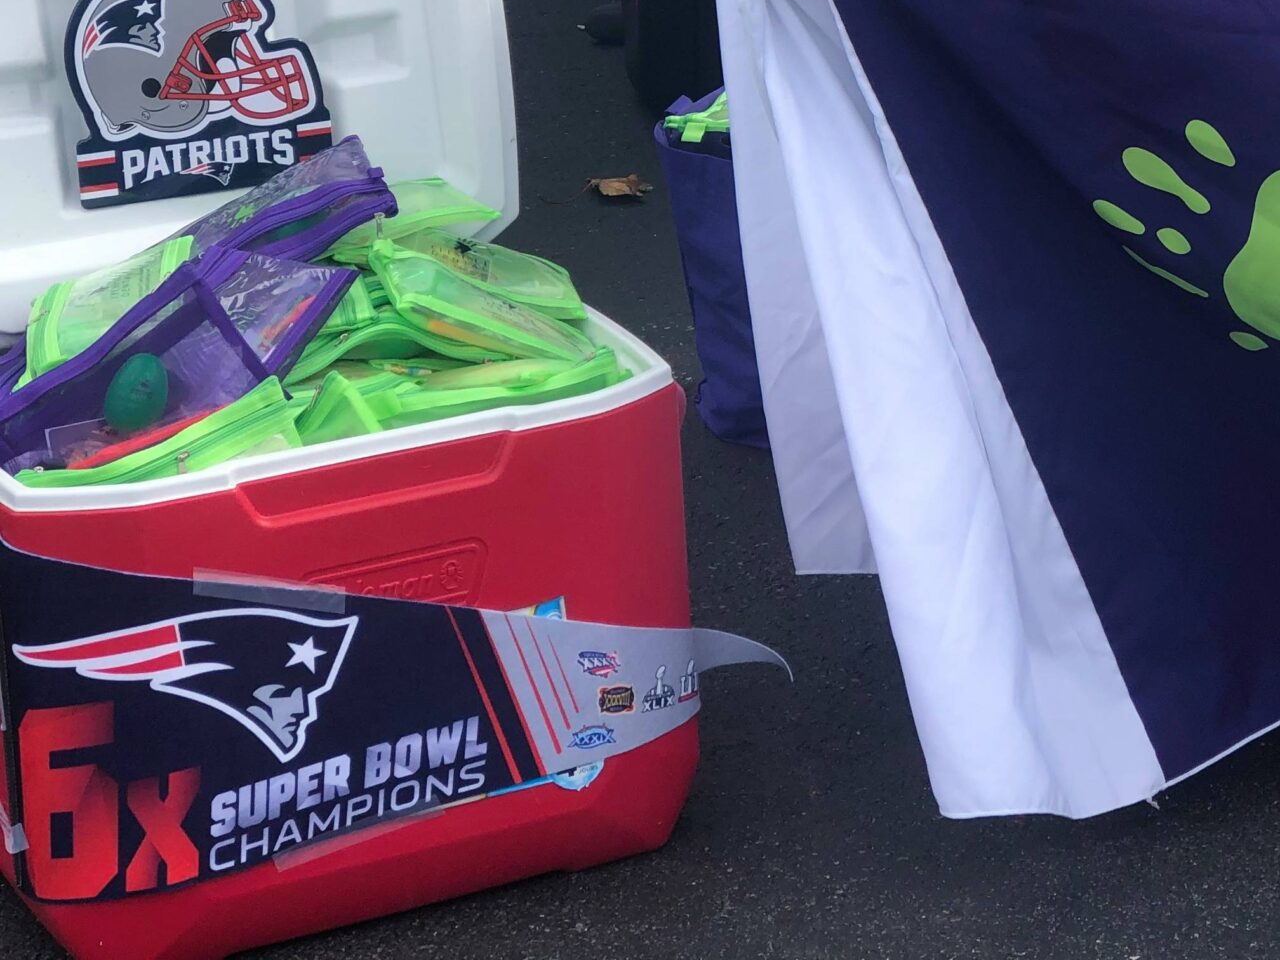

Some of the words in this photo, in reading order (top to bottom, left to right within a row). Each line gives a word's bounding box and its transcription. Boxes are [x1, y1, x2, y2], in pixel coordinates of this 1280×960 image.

[122, 128, 294, 190] PATRIOTS
[643, 696, 675, 712] XLIX
[209, 760, 486, 872] CHAMPIONS
[210, 754, 350, 838] SUPER
[364, 716, 488, 789] BOWL
